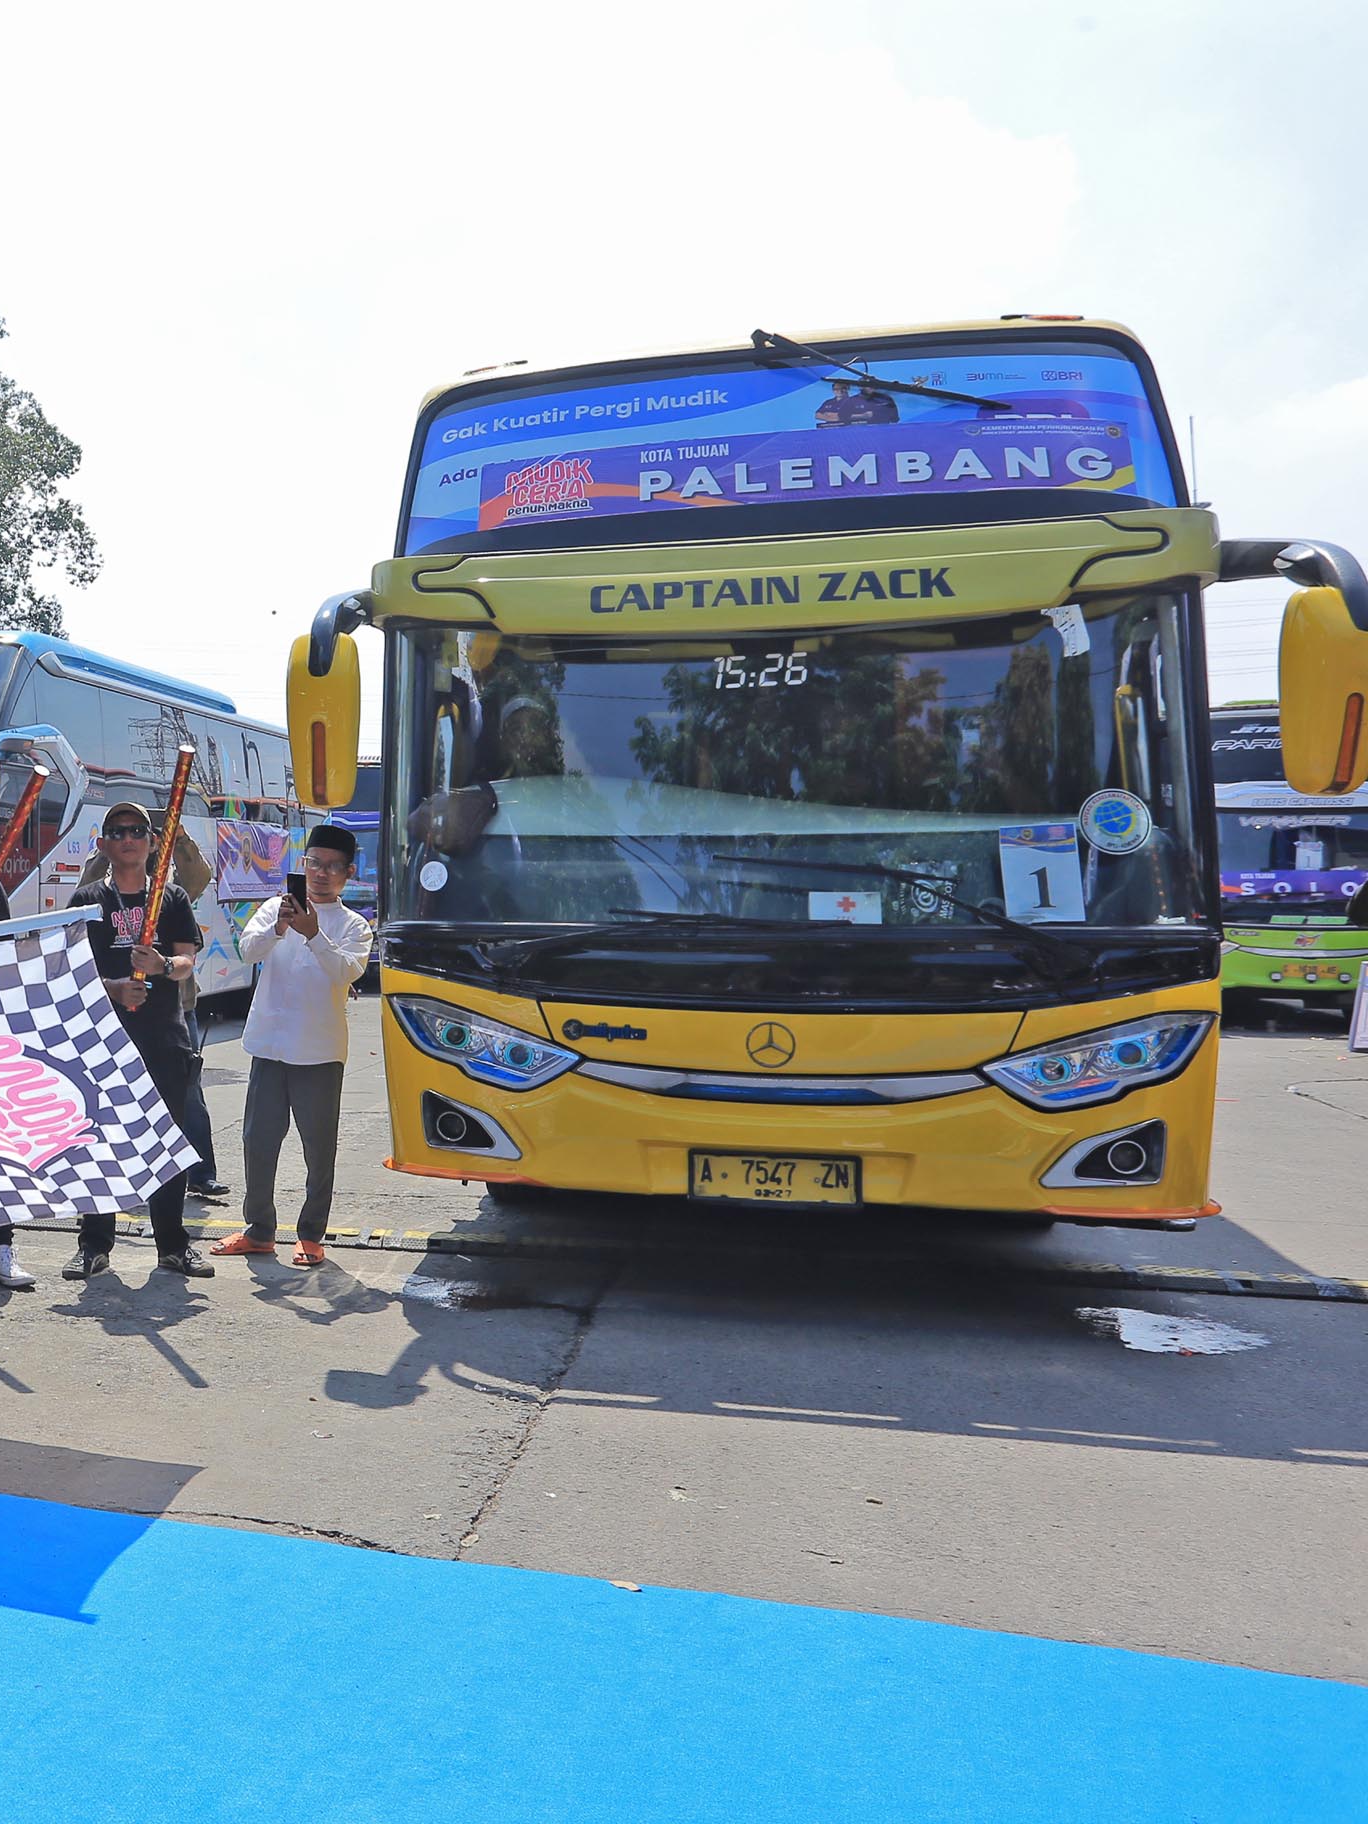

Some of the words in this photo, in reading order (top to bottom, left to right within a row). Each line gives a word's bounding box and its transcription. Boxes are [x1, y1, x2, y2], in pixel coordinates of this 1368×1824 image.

[441, 421, 489, 444] Gak
[492, 407, 570, 432] Kuatir
[574, 397, 641, 419] Pergi
[646, 389, 729, 411] Mudik
[640, 449, 673, 464] KOTA
[677, 443, 730, 460] TUJUAN
[438, 467, 479, 487] Ada
[638, 446, 1113, 502] PALEMBANG
[589, 575, 801, 614] CAPTAIN
[817, 567, 957, 602] ZACK
[714, 651, 808, 689] 15:26
[1027, 865, 1057, 909] 1
[1239, 881, 1360, 897] SOLO
[700, 1158, 713, 1183] A
[741, 1159, 797, 1186] 7547
[819, 1162, 850, 1189] ZN
